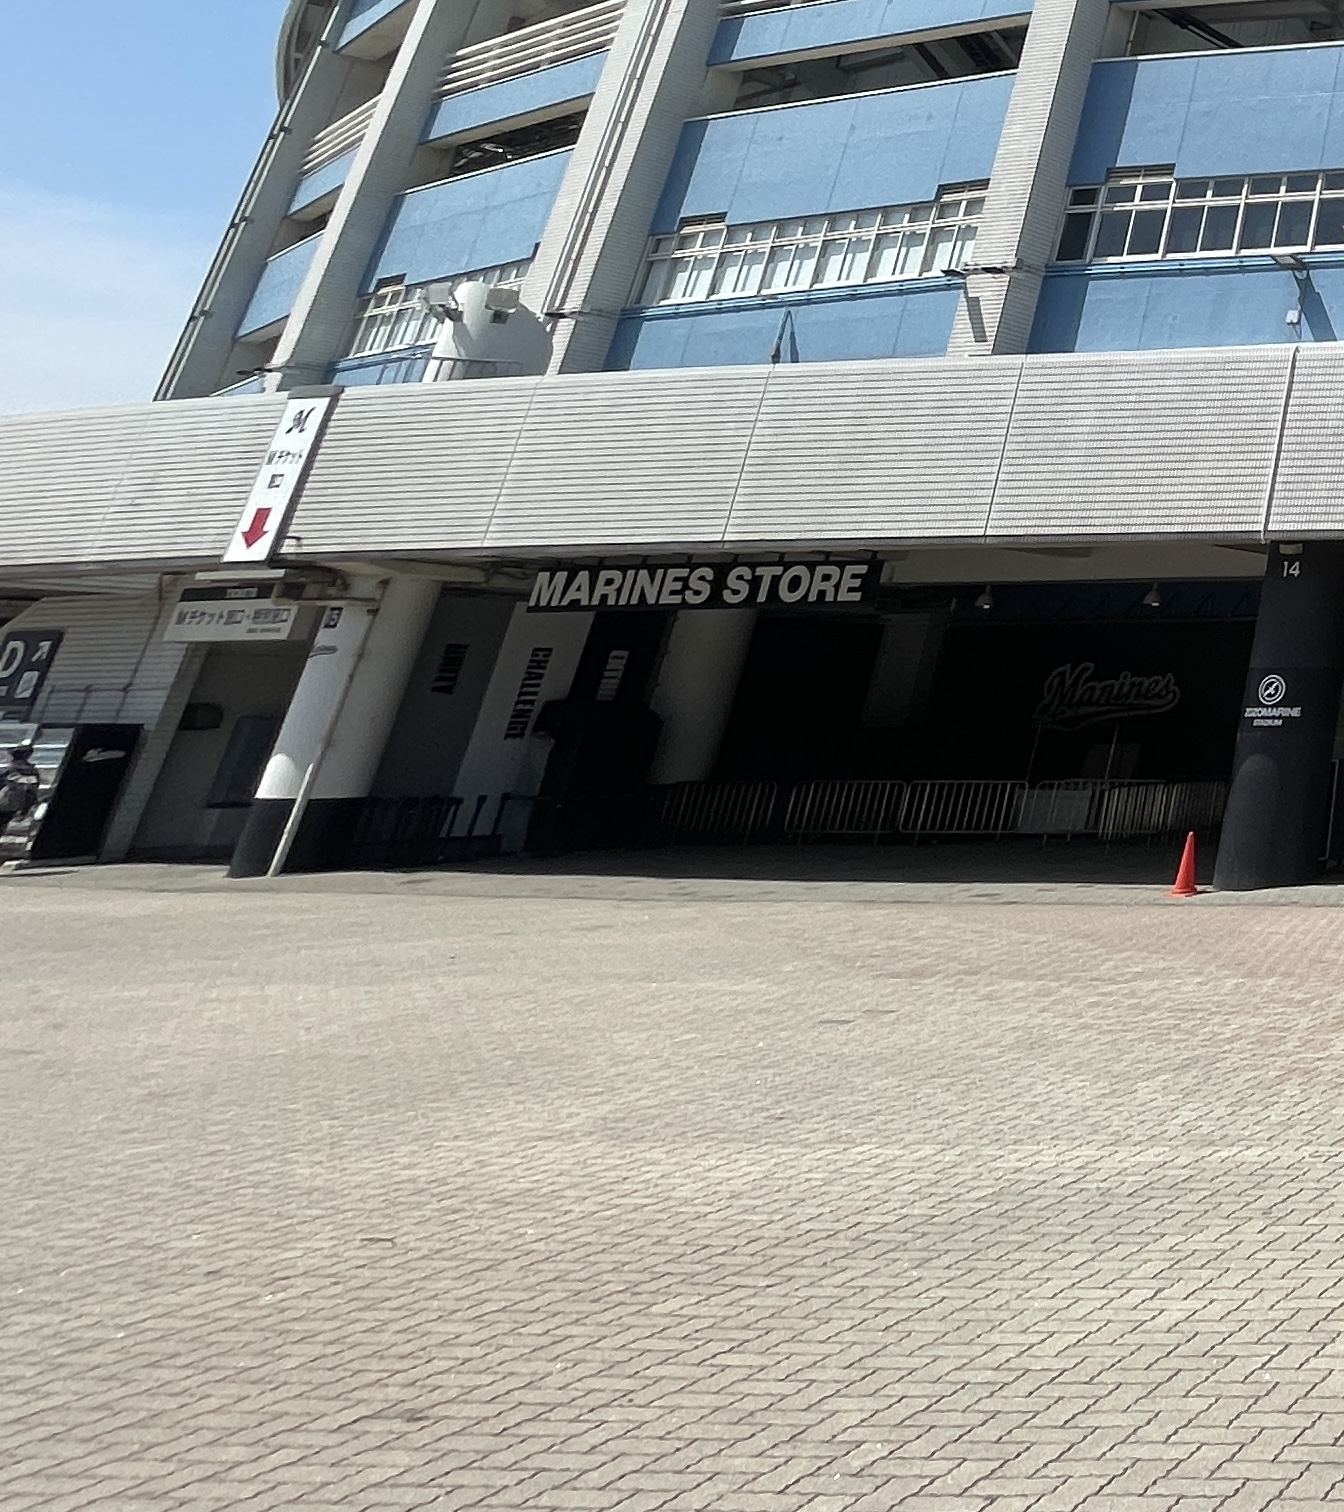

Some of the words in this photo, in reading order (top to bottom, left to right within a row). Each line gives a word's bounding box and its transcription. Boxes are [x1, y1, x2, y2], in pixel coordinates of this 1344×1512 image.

[528, 566, 714, 608] MARINES
[722, 564, 869, 604] STORE
[1282, 560, 1301, 578] 14
[503, 646, 554, 741] CHALLENGE
[1032, 662, 1181, 732] Marines
